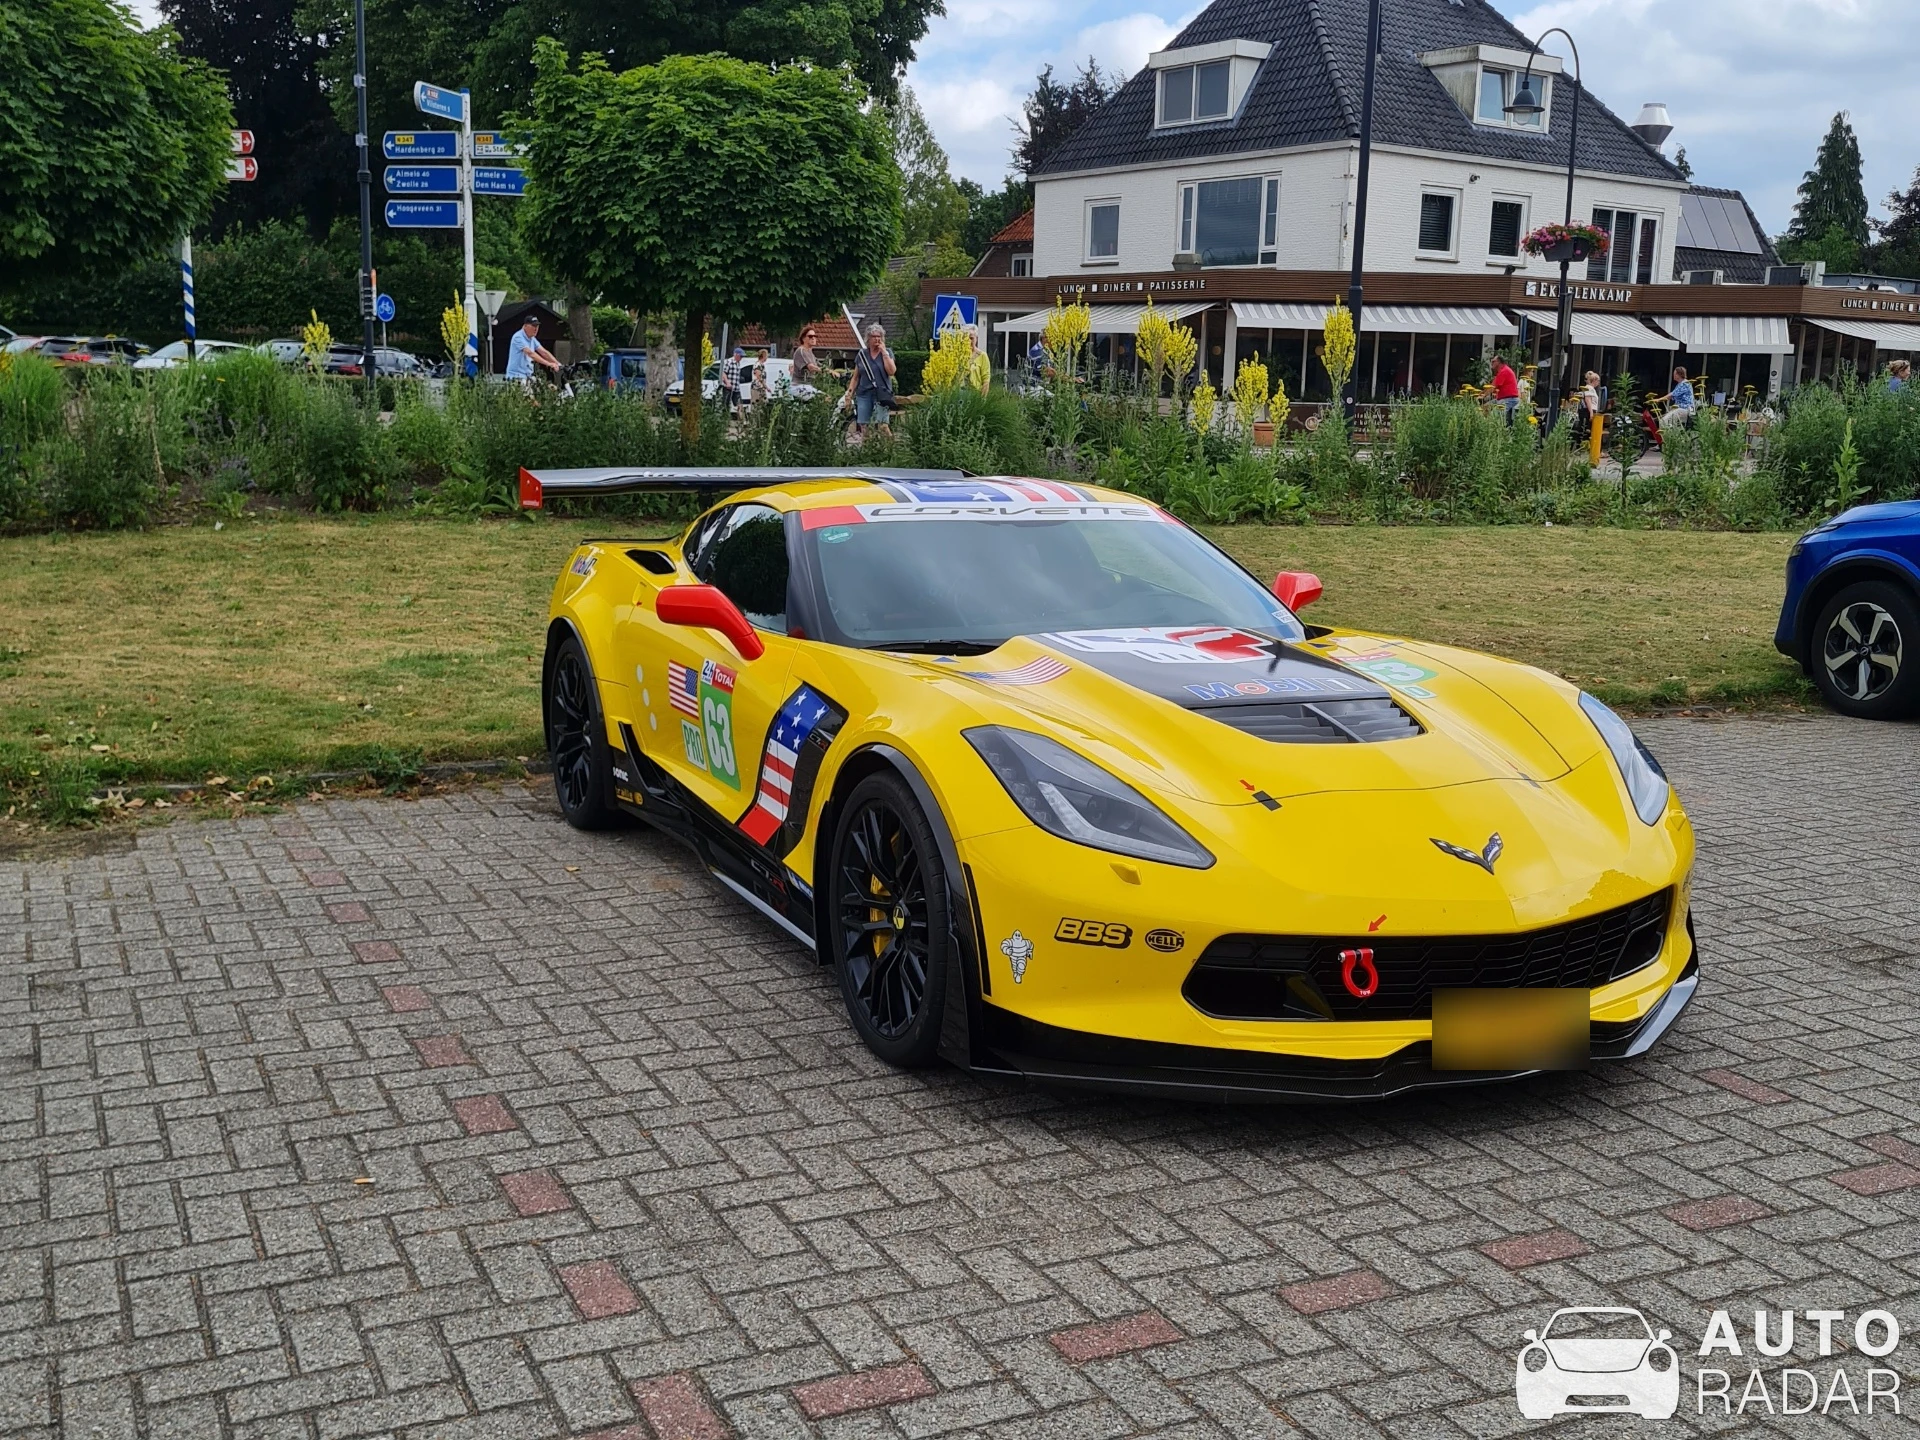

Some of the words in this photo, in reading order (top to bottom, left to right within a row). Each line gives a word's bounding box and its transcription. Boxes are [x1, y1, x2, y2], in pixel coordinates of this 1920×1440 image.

[395, 146, 436, 155] Hardenberg
[396, 170, 420, 178] Almelo
[475, 170, 500, 179] Lemele
[396, 180, 419, 188] Zwolle
[475, 180, 489, 189] Den
[490, 181, 507, 190] Ham
[396, 204, 434, 213] Hoogeveen
[1058, 283, 1086, 294] LUNCH
[1103, 282, 1131, 292] DINER
[1149, 279, 1206, 291] PATISSERIE
[1540, 282, 1632, 302] EKELENKAMP
[1842, 298, 1868, 309] LUNCH
[1881, 301, 1905, 311] DINER
[870, 506, 1151, 517] CORVETTE
[1182, 677, 1325, 701] Mobil
[703, 696, 736, 777] 63
[683, 723, 705, 766] PRO
[1054, 916, 1134, 950] BBS
